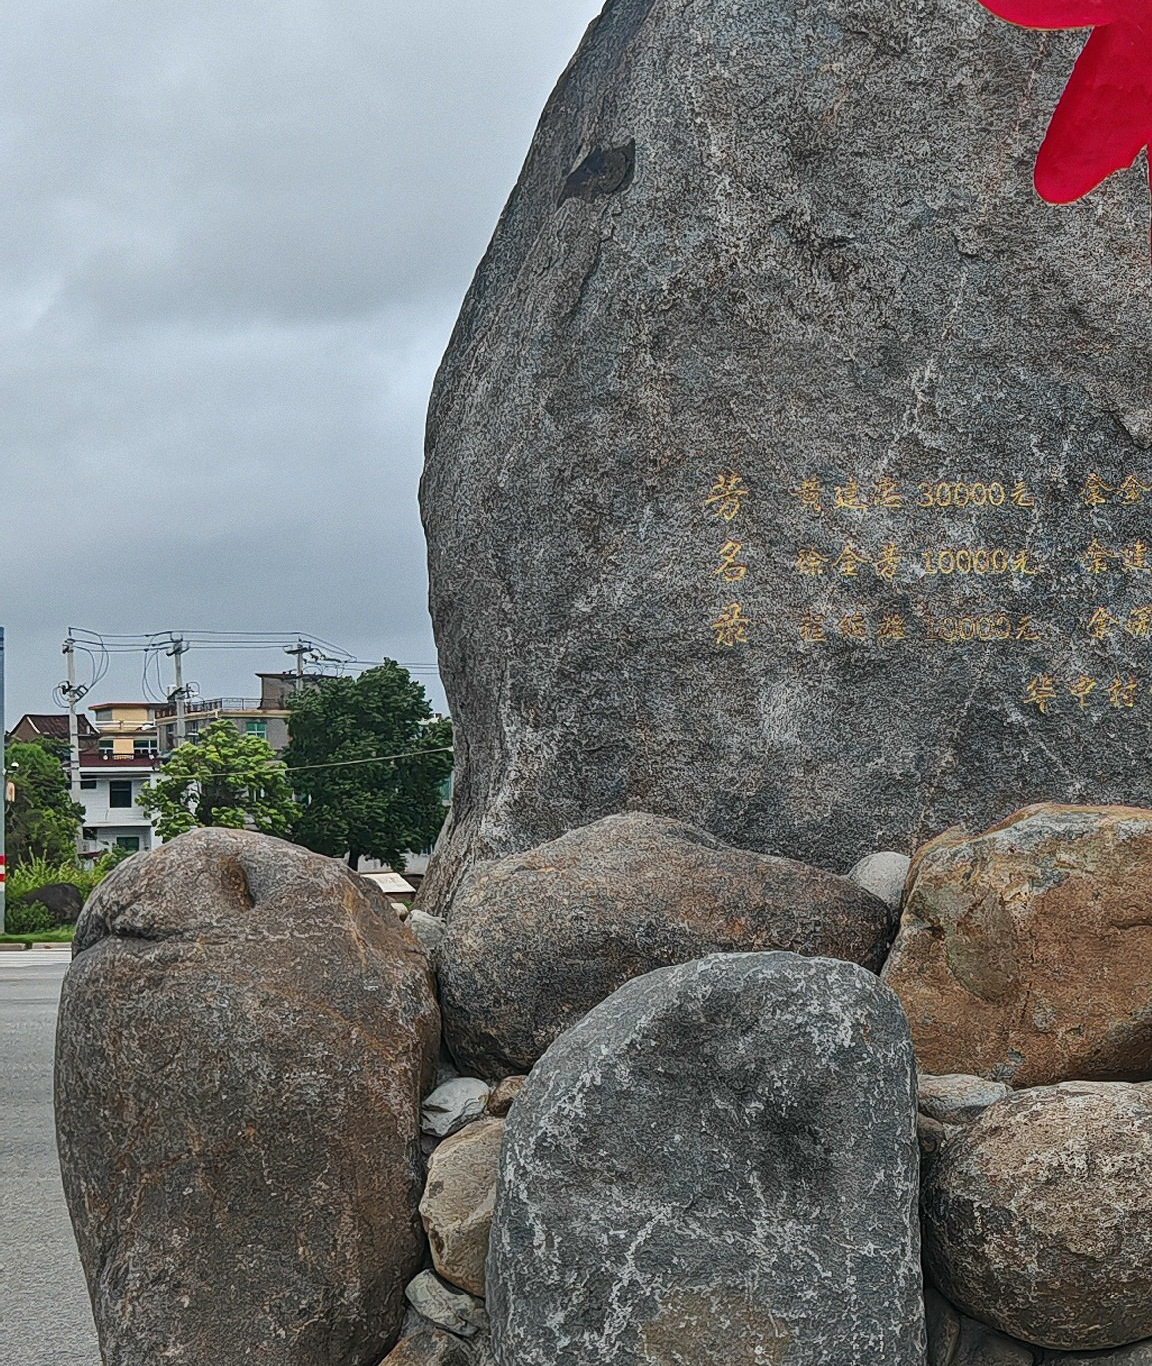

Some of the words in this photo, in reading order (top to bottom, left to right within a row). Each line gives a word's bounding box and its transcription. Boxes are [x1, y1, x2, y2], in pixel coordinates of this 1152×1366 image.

[918, 479, 1034, 508] 30000元
[704, 471, 749, 647] 芳名录
[923, 547, 1039, 575] 10000元
[925, 615, 1041, 641] 10000元
